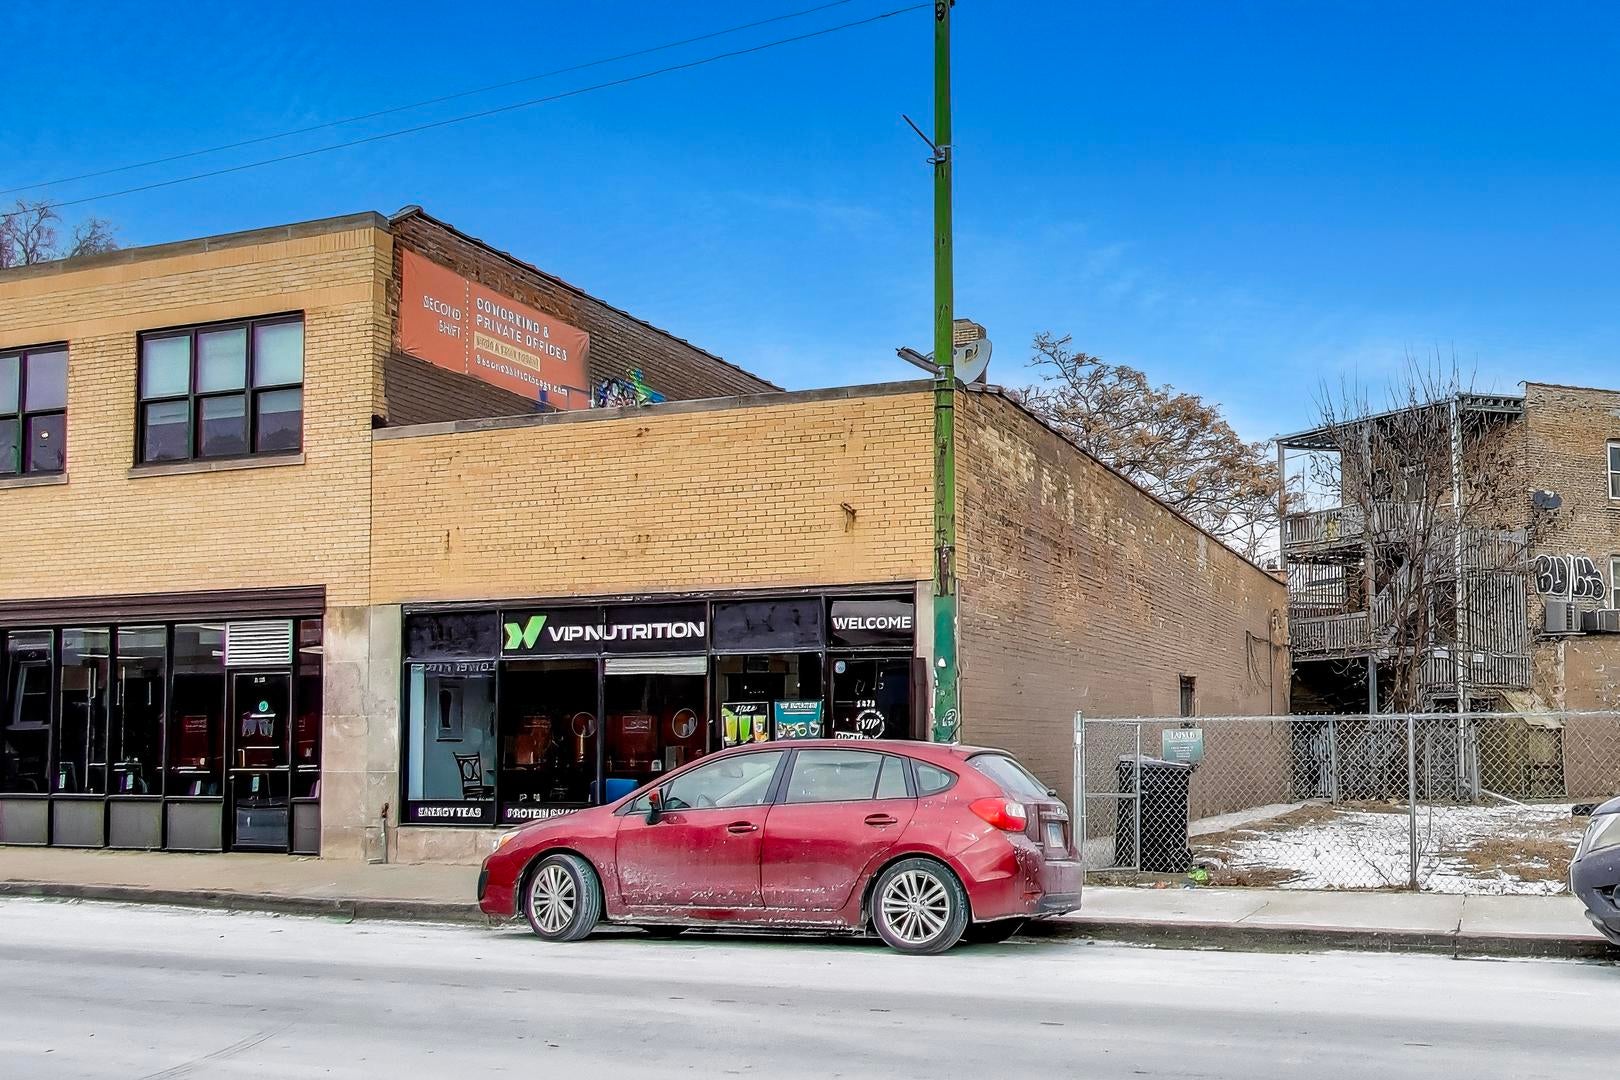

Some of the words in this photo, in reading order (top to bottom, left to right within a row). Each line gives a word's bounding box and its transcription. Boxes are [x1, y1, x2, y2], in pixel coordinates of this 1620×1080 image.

[423, 295, 461, 321] SECOND
[476, 314, 522, 343] PRIVATE
[526, 334, 567, 361] OFFICES
[543, 326, 550, 338] &
[832, 616, 912, 630] WELCOME
[456, 807, 482, 818] TEAS
